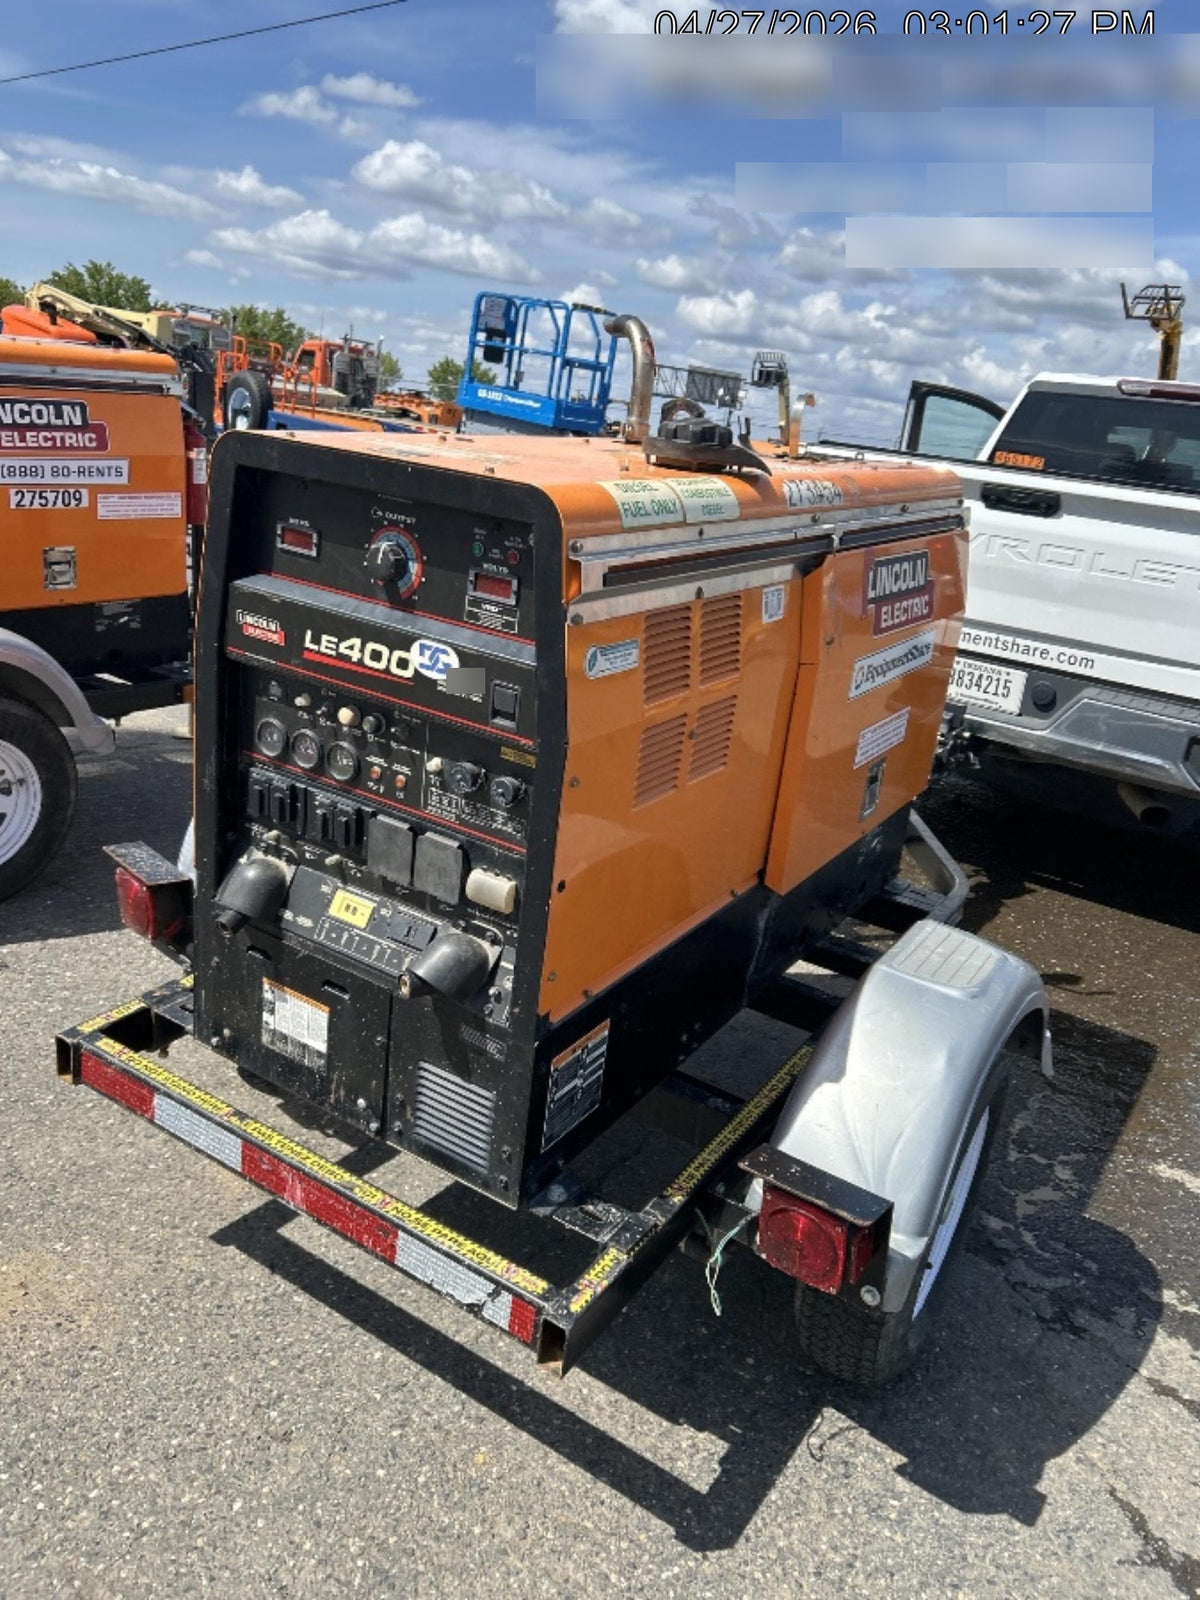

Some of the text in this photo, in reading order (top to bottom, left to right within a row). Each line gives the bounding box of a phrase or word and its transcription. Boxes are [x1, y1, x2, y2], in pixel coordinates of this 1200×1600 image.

[1, 431, 97, 447] ELECTRIC
[51, 466, 123, 478] 80-RENTS
[15, 490, 83, 507] 275709
[620, 498, 678, 518] FUEL ONLY
[868, 558, 926, 599] LINCOLN
[881, 595, 929, 628] ELECTRIC
[304, 628, 416, 678] LE400
[391, 1206, 411, 1218] NO
